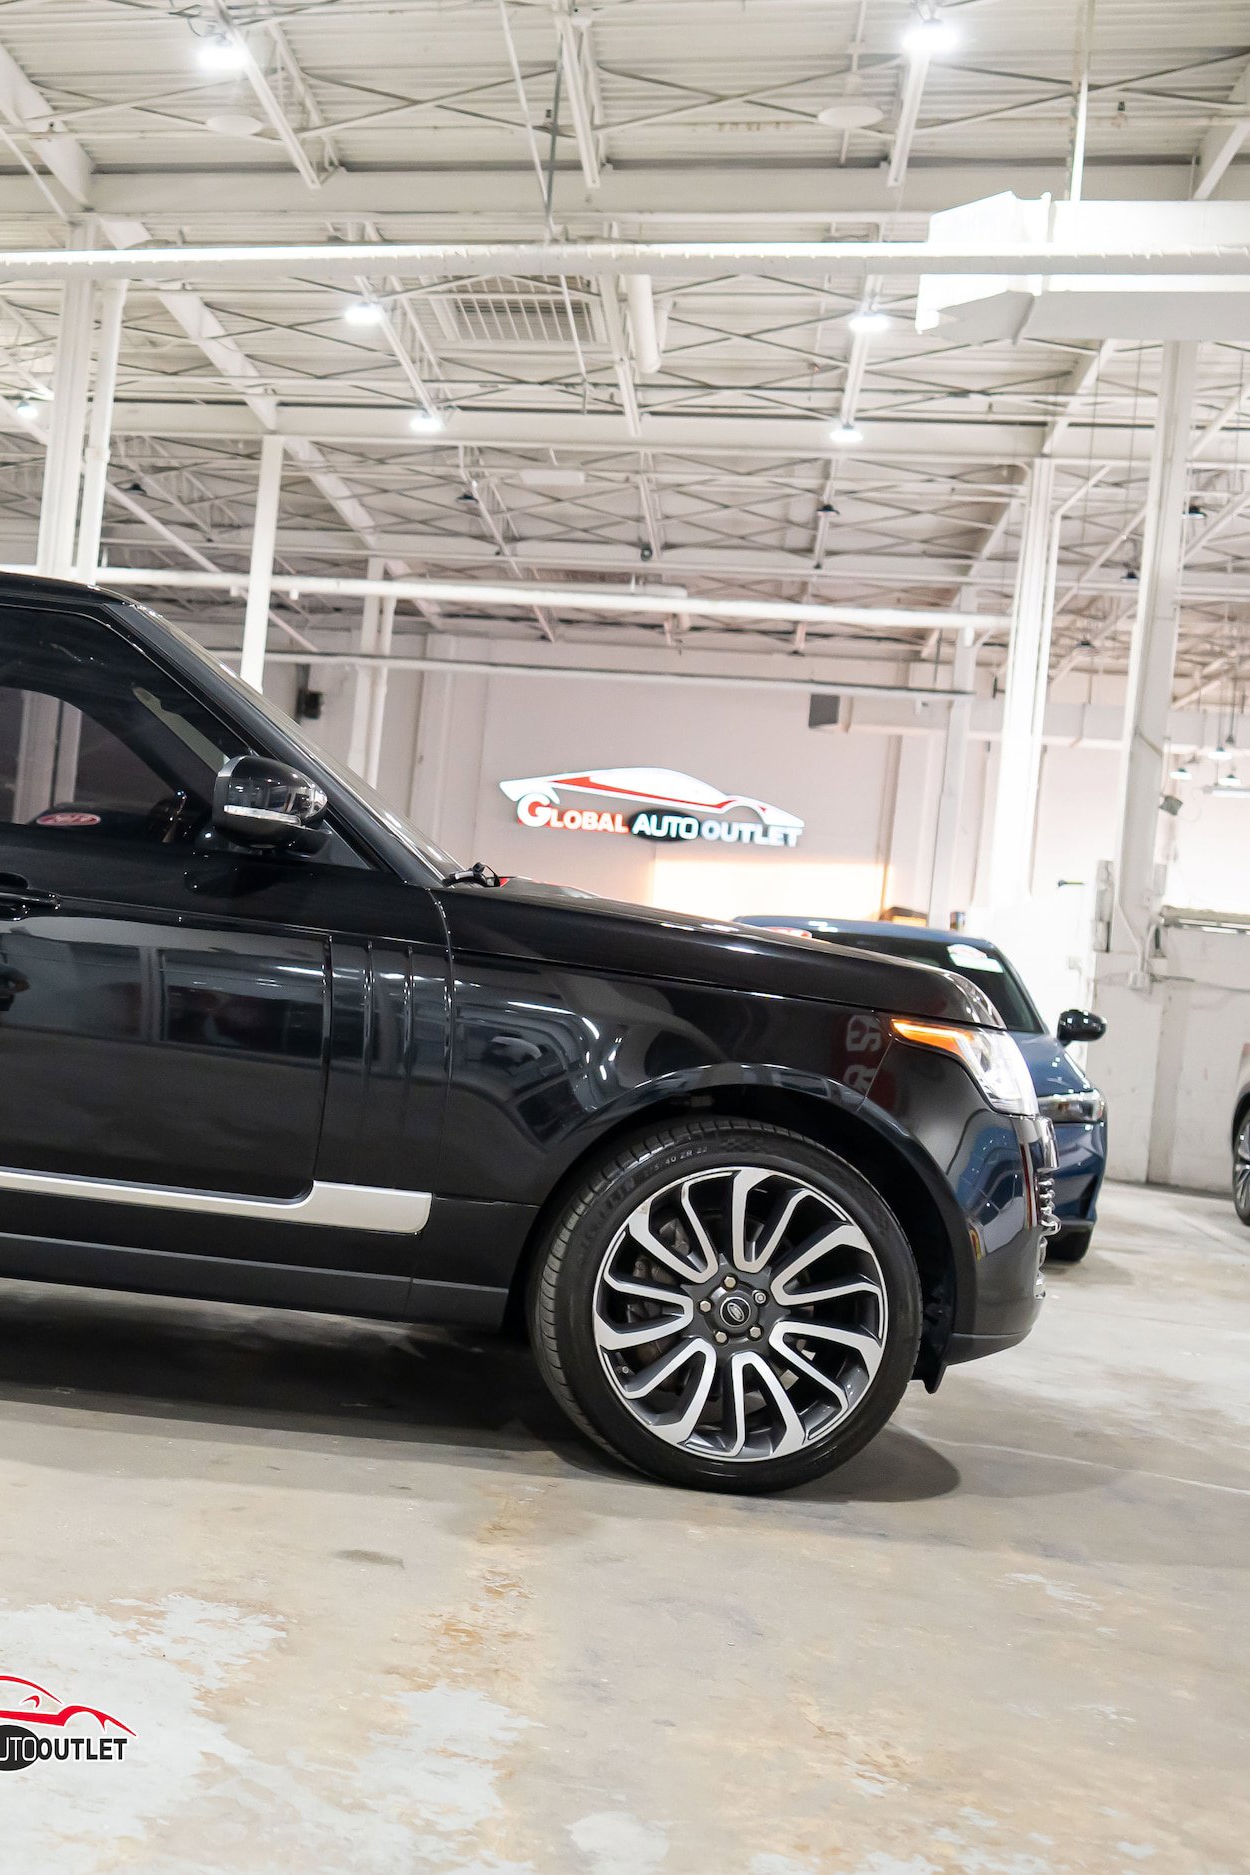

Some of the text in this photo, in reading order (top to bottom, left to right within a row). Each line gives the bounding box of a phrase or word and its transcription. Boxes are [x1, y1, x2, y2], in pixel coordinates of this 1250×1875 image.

[517, 793, 803, 848] GLOBAL AUTO OUTLET
